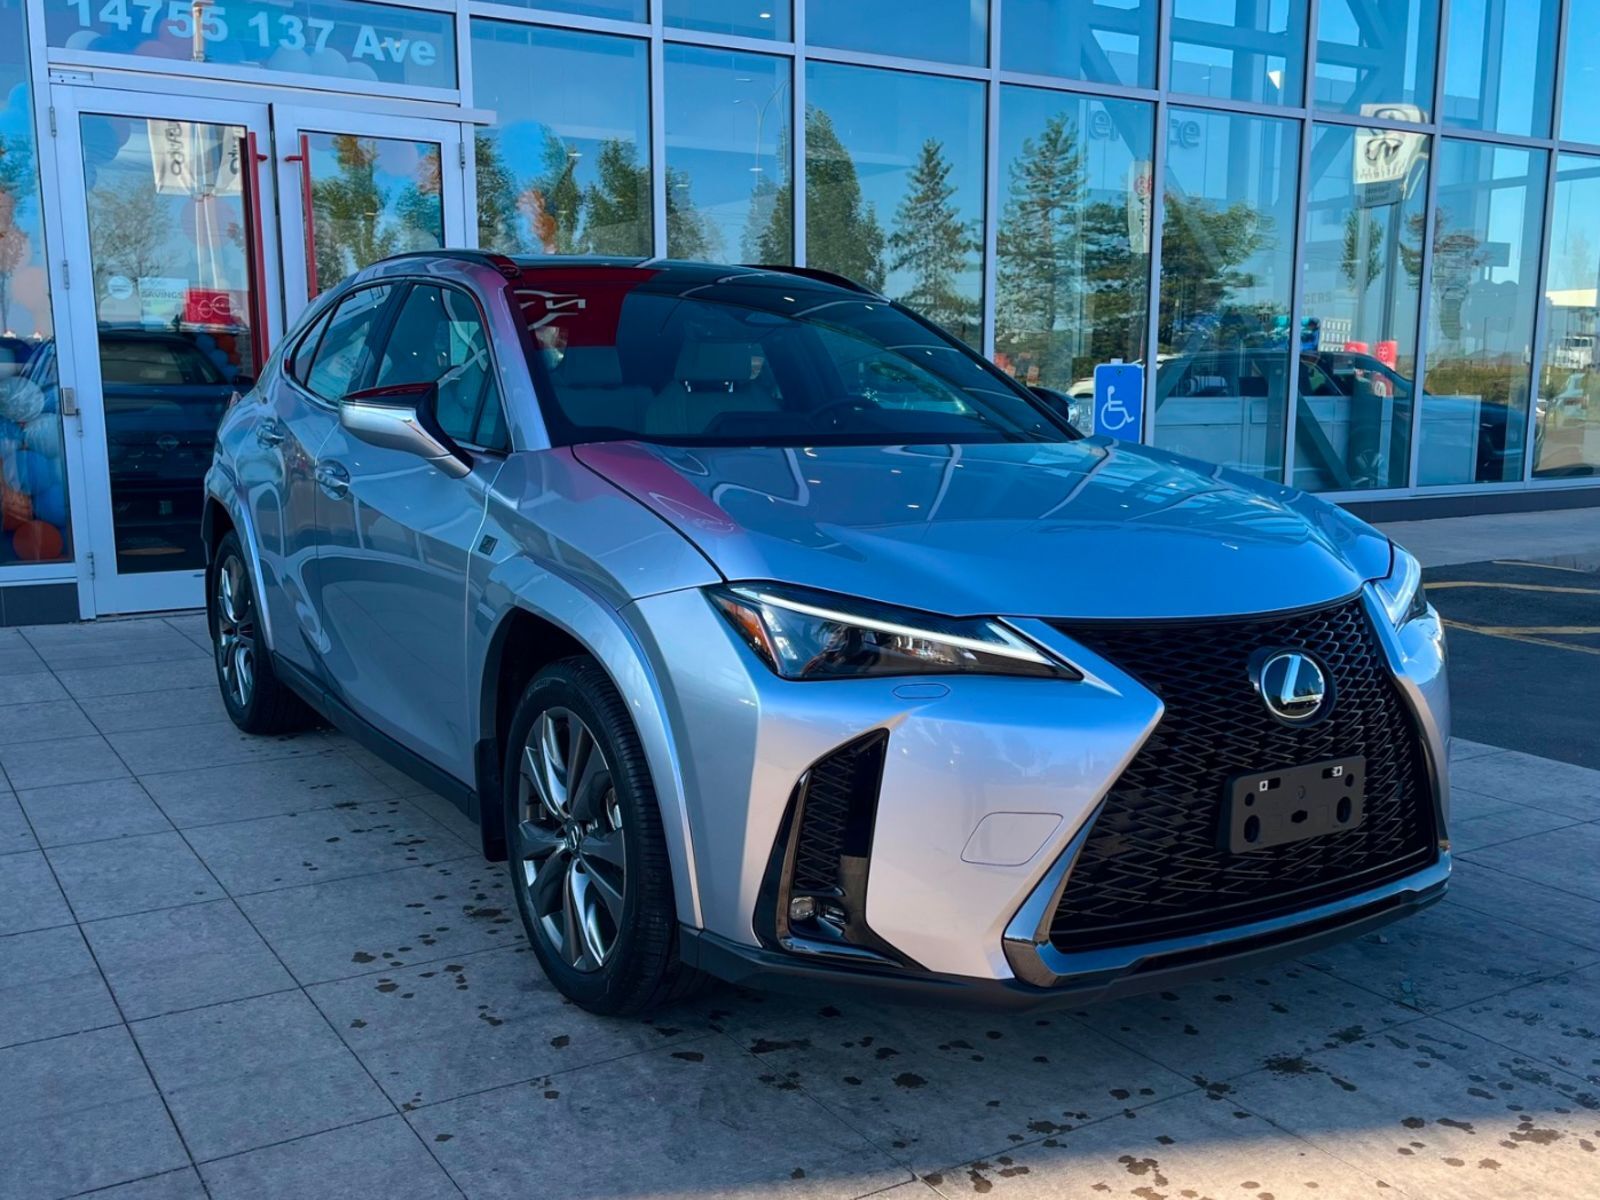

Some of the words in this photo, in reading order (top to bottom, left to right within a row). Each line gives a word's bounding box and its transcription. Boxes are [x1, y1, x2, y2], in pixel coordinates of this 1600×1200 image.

[67, 0, 228, 42] 14755
[247, 11, 335, 54] 137
[351, 25, 436, 66] Ave
